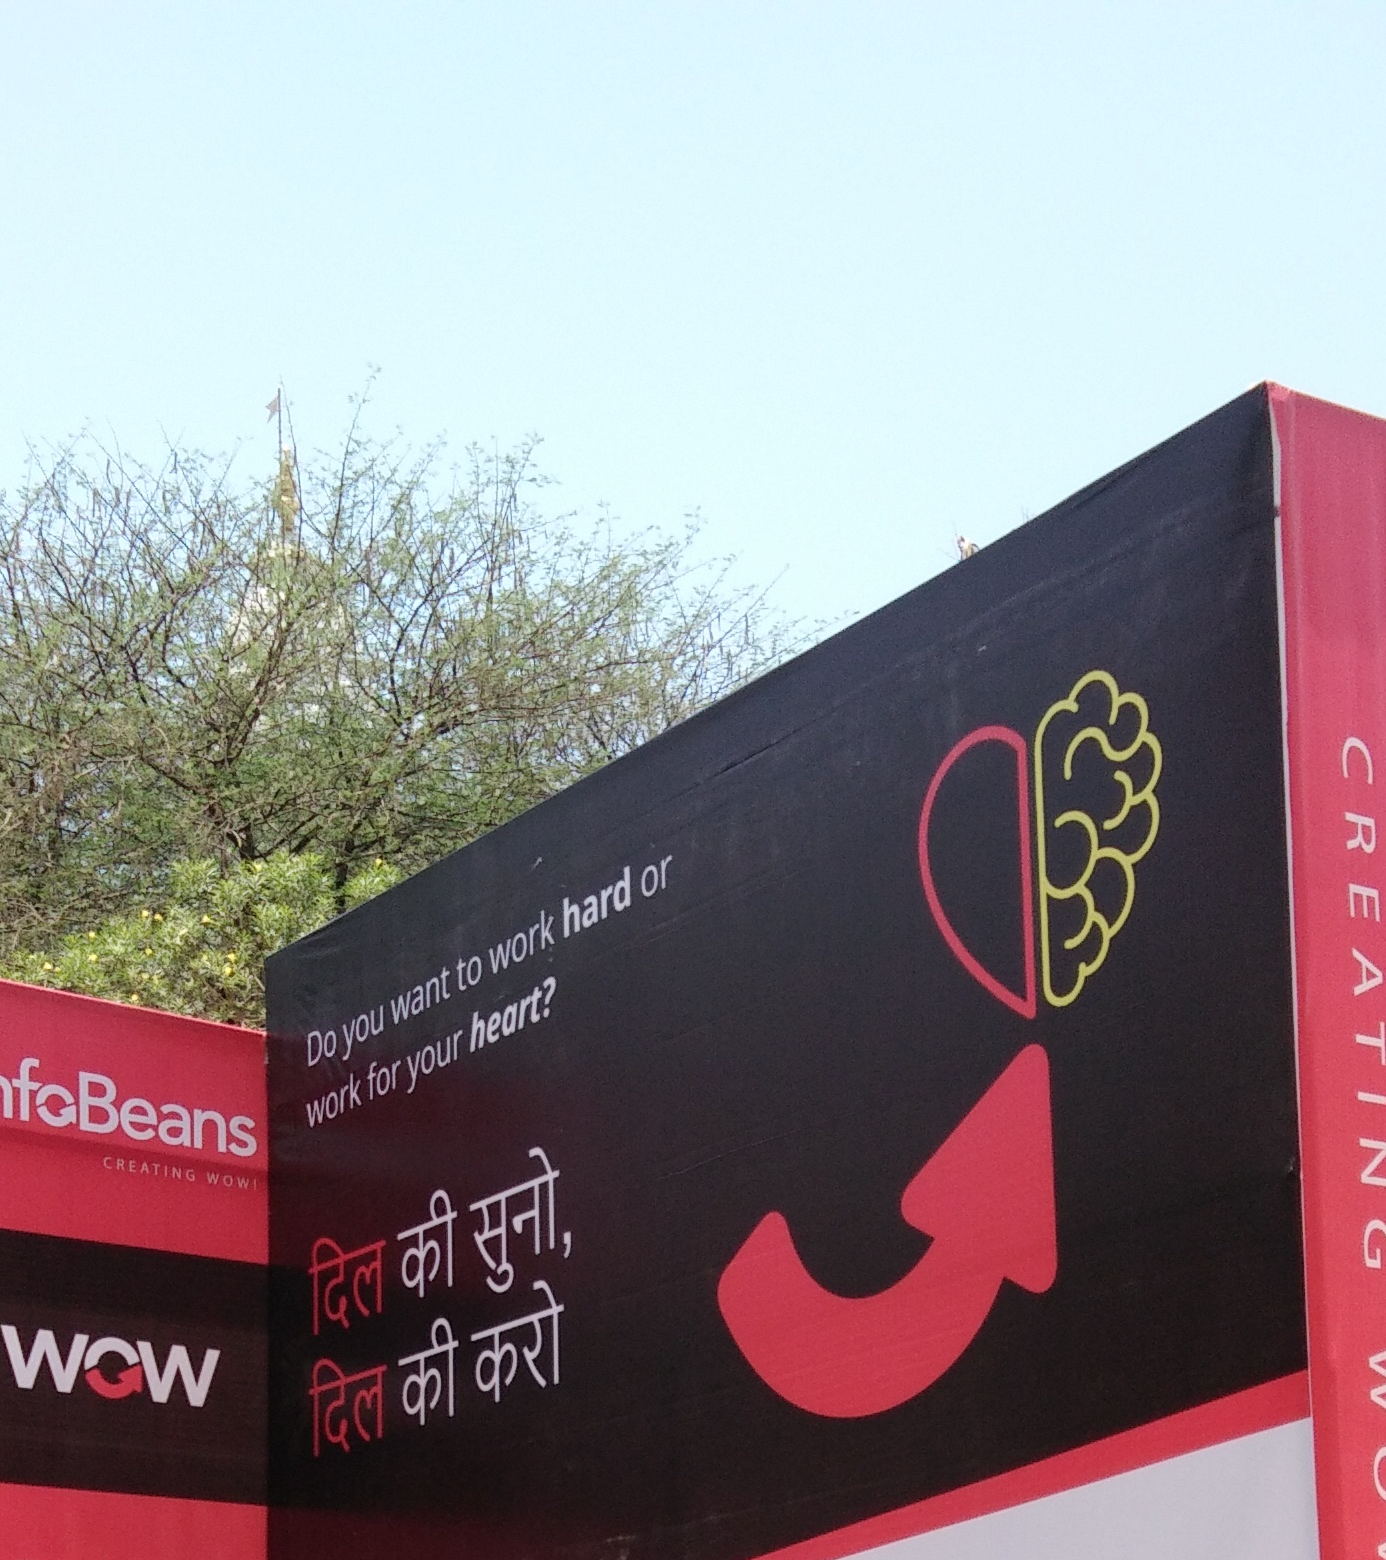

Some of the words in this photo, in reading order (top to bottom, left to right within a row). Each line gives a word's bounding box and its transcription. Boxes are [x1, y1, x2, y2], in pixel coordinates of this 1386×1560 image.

[307, 1026, 336, 1068] Do
[341, 1005, 384, 1061] you
[391, 966, 450, 1025] want
[457, 955, 482, 992] to
[488, 910, 555, 975] work
[562, 866, 631, 938] hard
[641, 854, 673, 898] or
[306, 1078, 362, 1128] work
[367, 1059, 400, 1101] for
[406, 1030, 463, 1094] your
[470, 976, 557, 1053] heart?
[103, 1156, 197, 1183] CREATING
[206, 1171, 258, 1190] WOW!
[308, 1237, 386, 1336] दिल
[396, 1189, 458, 1298] की
[469, 1147, 571, 1293] सुनो,
[0, 1325, 220, 1408] WOW
[309, 1358, 388, 1457] दिल
[398, 1317, 459, 1426] की
[471, 1280, 564, 1403] करो
